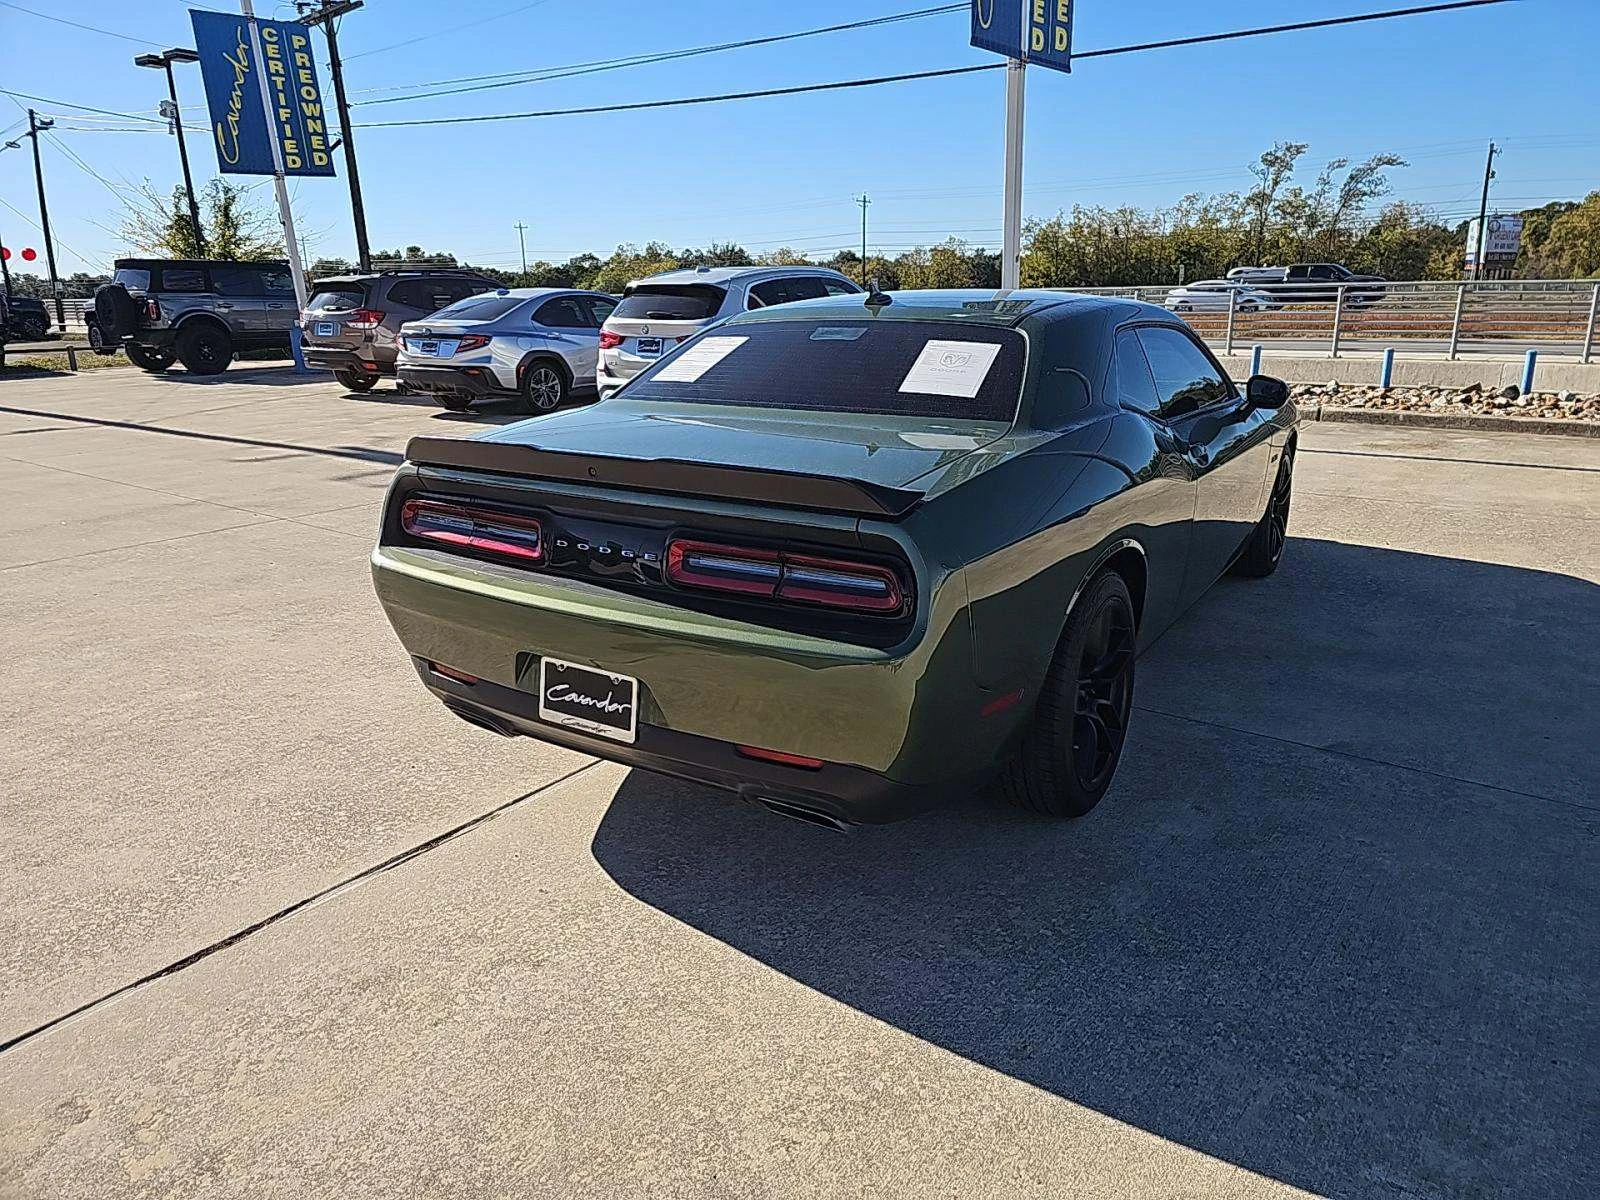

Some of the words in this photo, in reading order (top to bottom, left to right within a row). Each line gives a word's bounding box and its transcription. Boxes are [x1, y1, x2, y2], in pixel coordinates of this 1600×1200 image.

[216, 25, 250, 165] Cavender
[262, 27, 302, 169] CERTIFIED
[291, 34, 328, 167] PREOWNED
[556, 539, 657, 561] DODGE
[546, 683, 632, 714] Cavender
